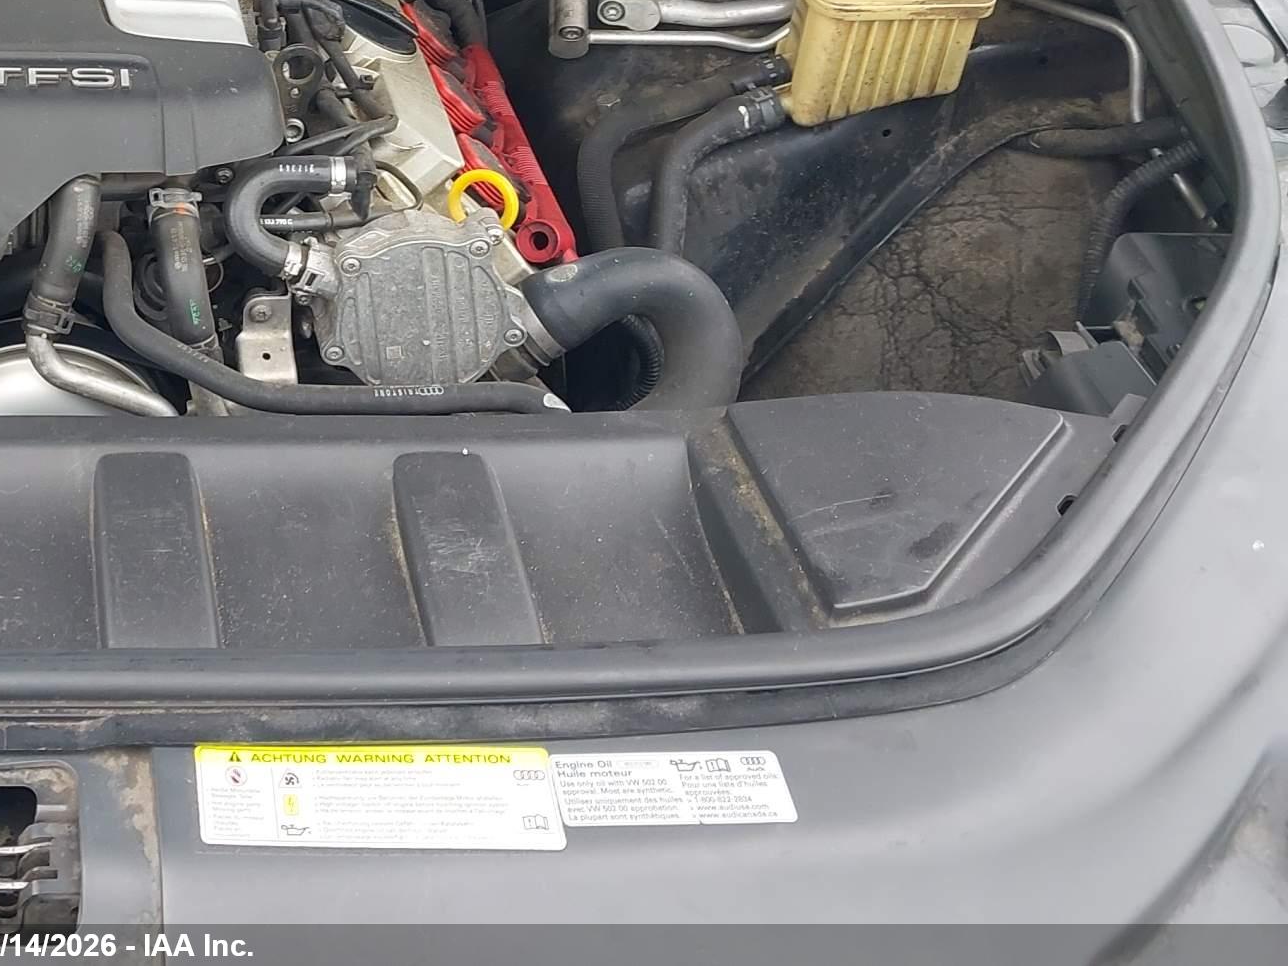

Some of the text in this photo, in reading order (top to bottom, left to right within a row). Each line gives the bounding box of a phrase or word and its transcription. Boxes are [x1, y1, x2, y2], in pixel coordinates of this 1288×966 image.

[251, 752, 511, 764] ACHTUNG WARNING ATTENTION
[555, 760, 594, 771] Engine
[597, 760, 613, 769] Oil
[557, 770, 632, 778] Huile moteur
